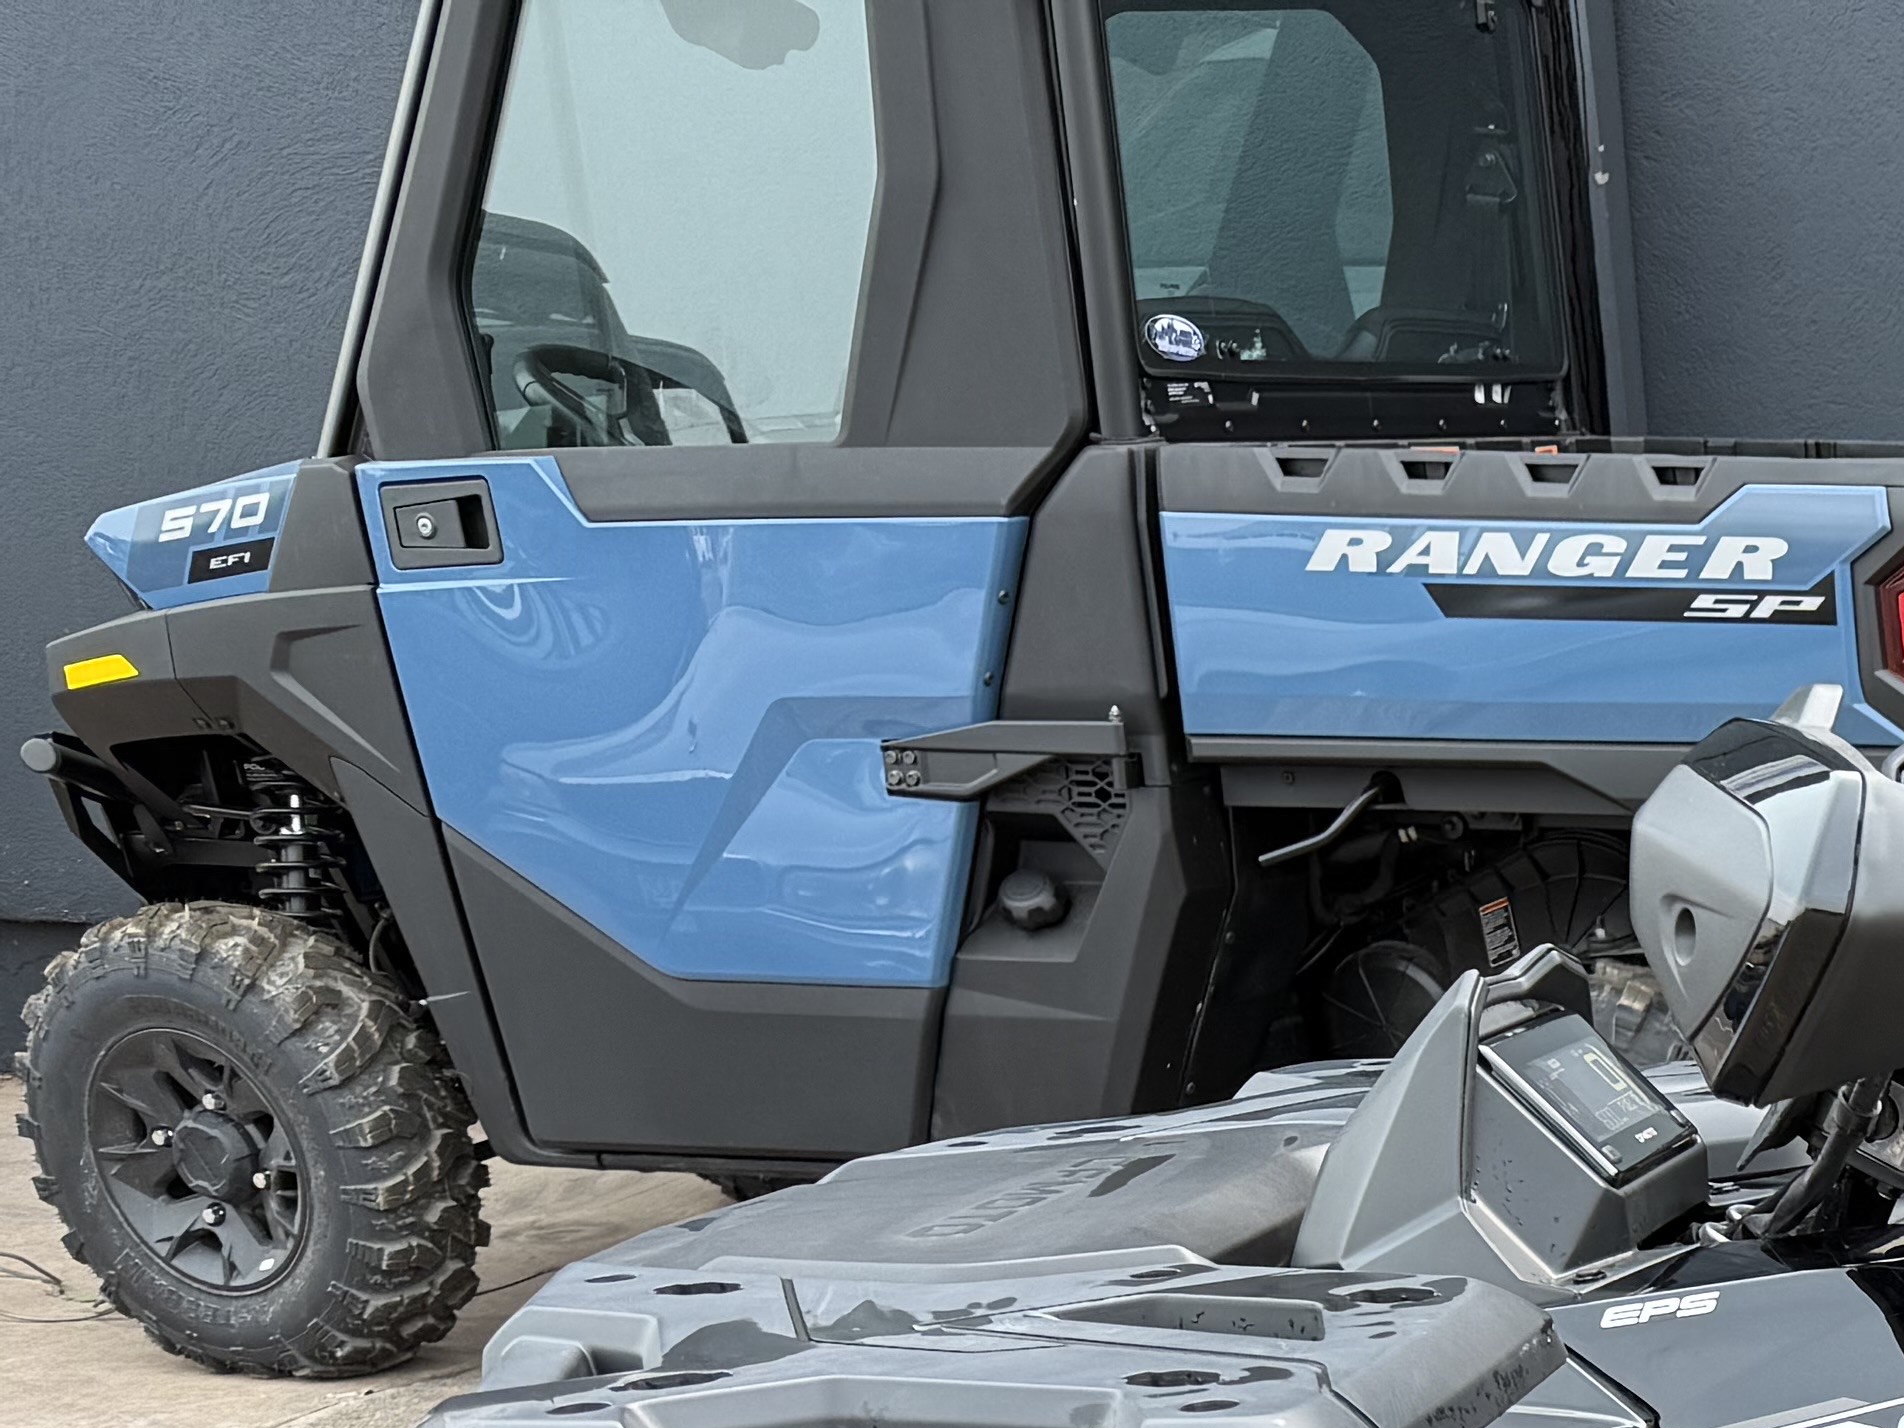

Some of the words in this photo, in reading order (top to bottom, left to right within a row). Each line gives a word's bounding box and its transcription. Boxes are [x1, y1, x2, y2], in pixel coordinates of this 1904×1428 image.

[158, 492, 270, 543] 570
[209, 551, 251, 569] EFI
[1305, 529, 1788, 580] RANGER
[1682, 594, 1826, 619] SP
[1600, 1291, 1720, 1328] EPS
